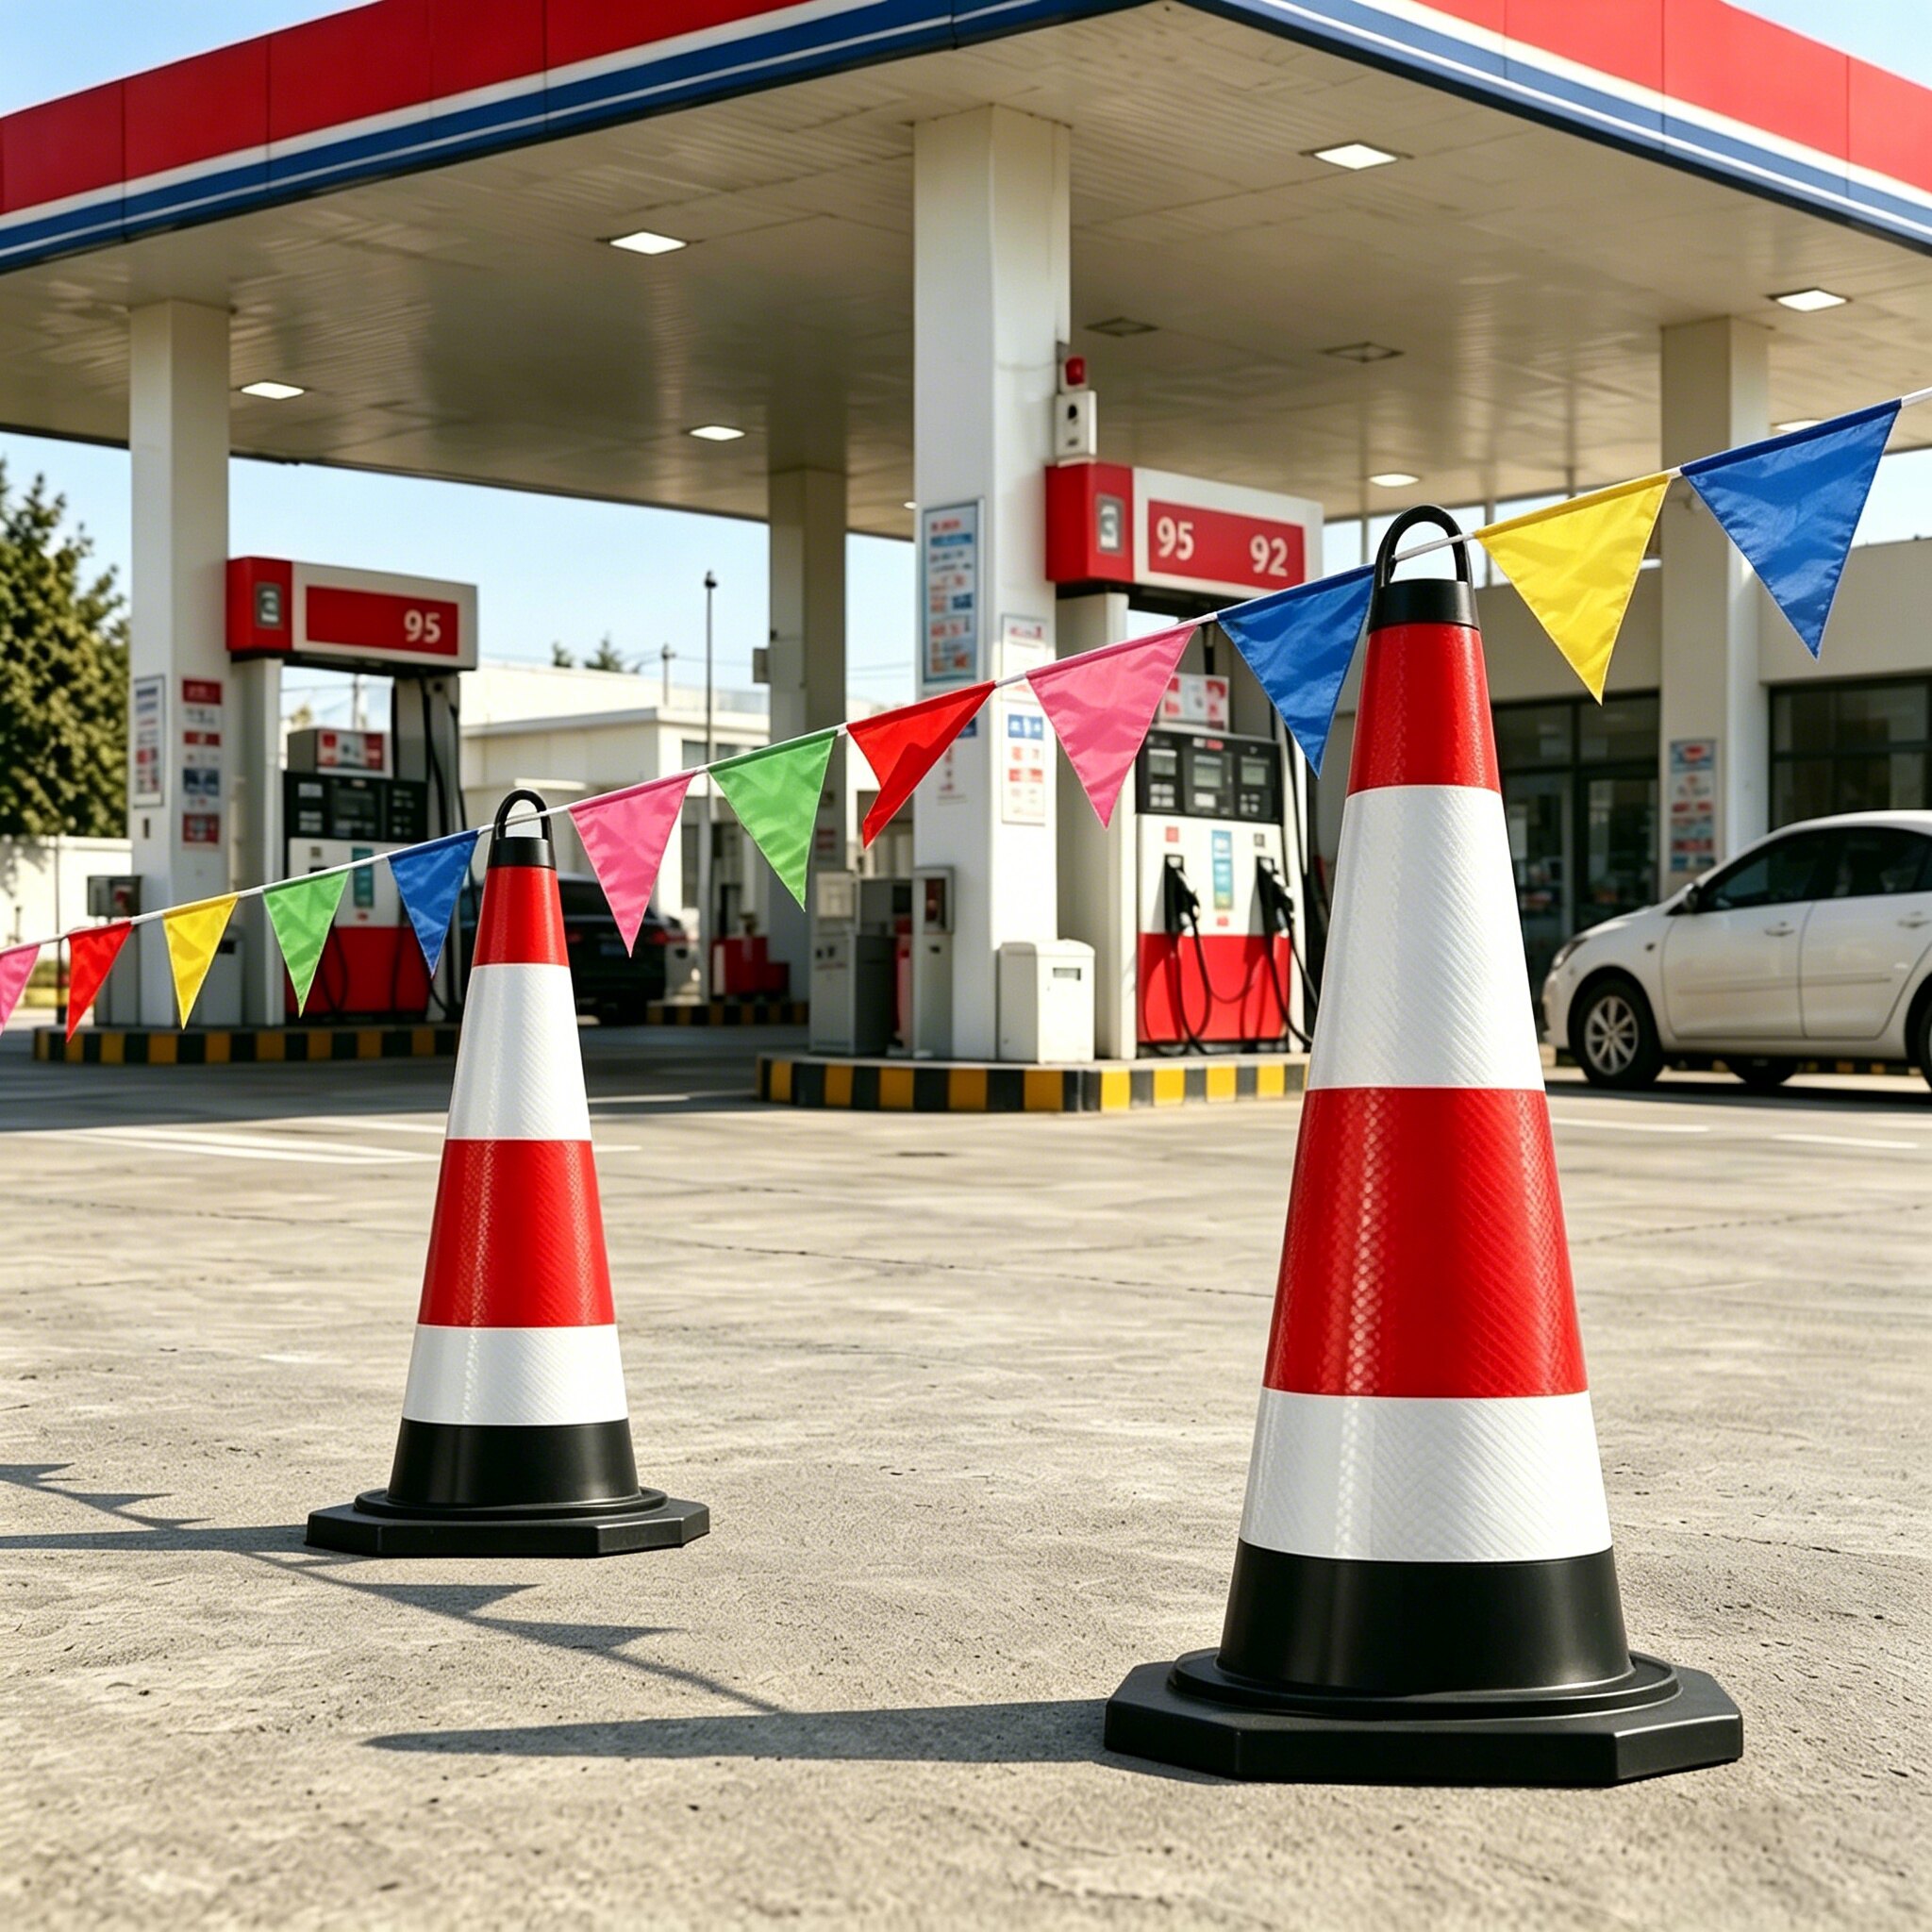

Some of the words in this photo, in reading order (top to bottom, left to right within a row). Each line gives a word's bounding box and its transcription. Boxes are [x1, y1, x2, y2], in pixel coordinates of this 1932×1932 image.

[1157, 516, 1194, 560] 95
[1250, 534, 1289, 577] 92
[404, 609, 441, 644] 95
